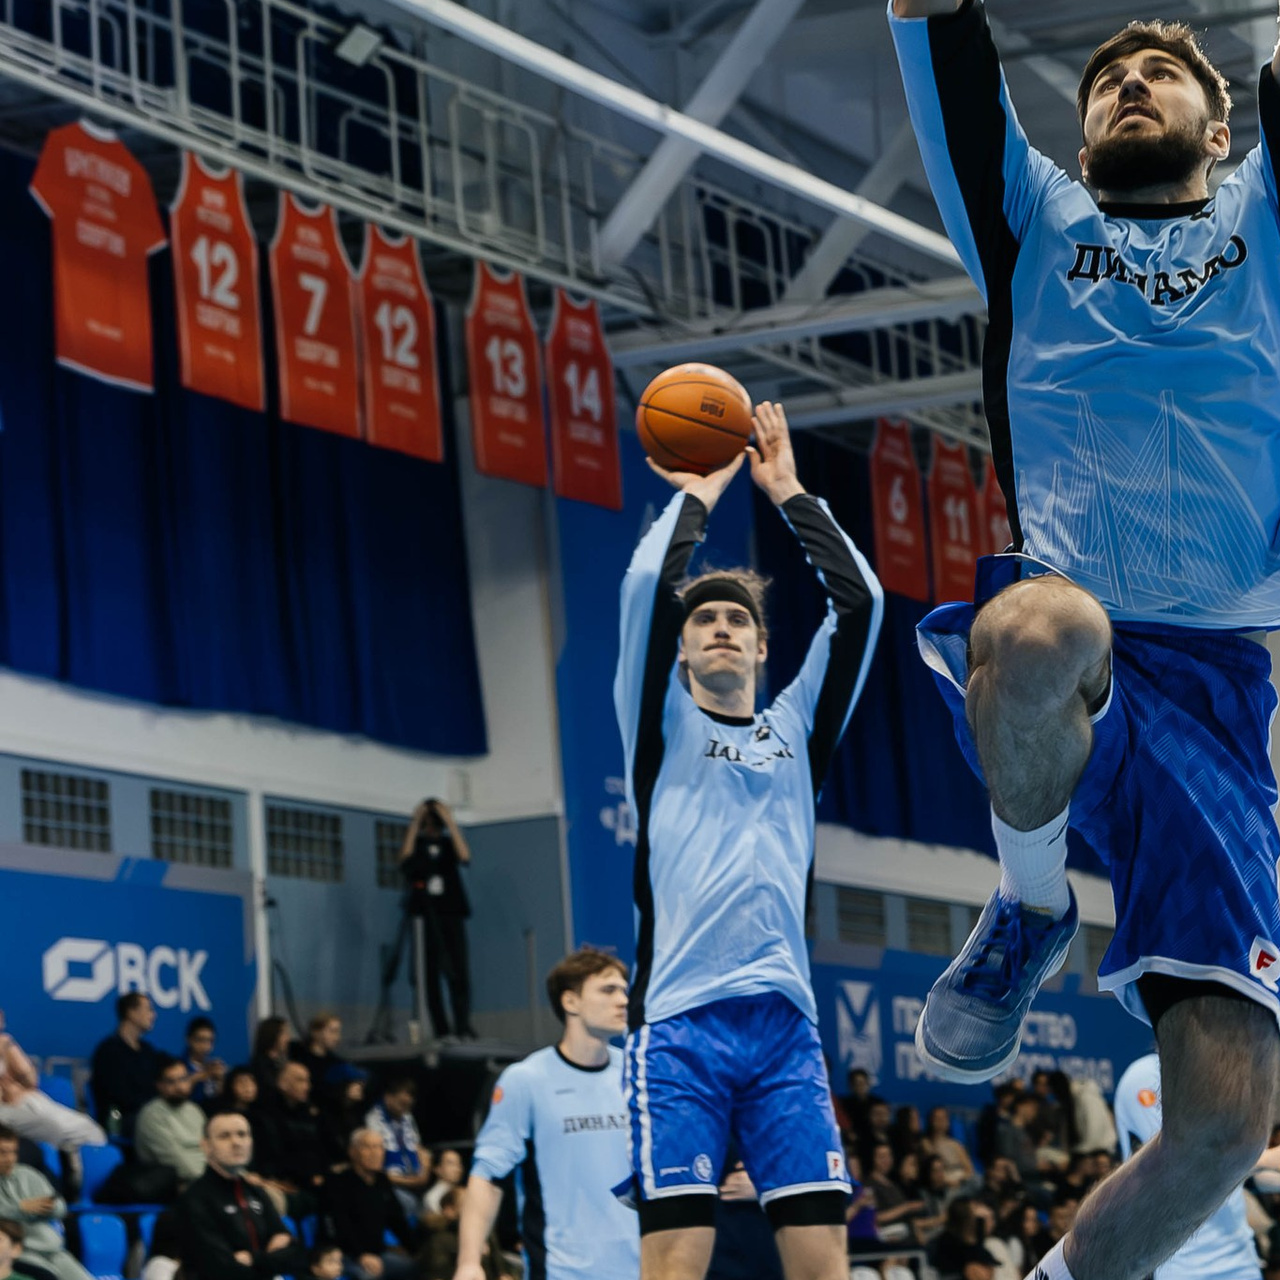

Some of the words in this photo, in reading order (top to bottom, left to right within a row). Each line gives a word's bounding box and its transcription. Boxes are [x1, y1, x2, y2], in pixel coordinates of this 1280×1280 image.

[190, 235, 240, 310] 12
[298, 273, 328, 336] 7
[374, 301, 420, 369] 12
[486, 335, 527, 398] 13
[564, 361, 602, 423] 14
[889, 477, 910, 522] 6
[943, 497, 971, 546] 11
[115, 942, 212, 1011] ВСК
